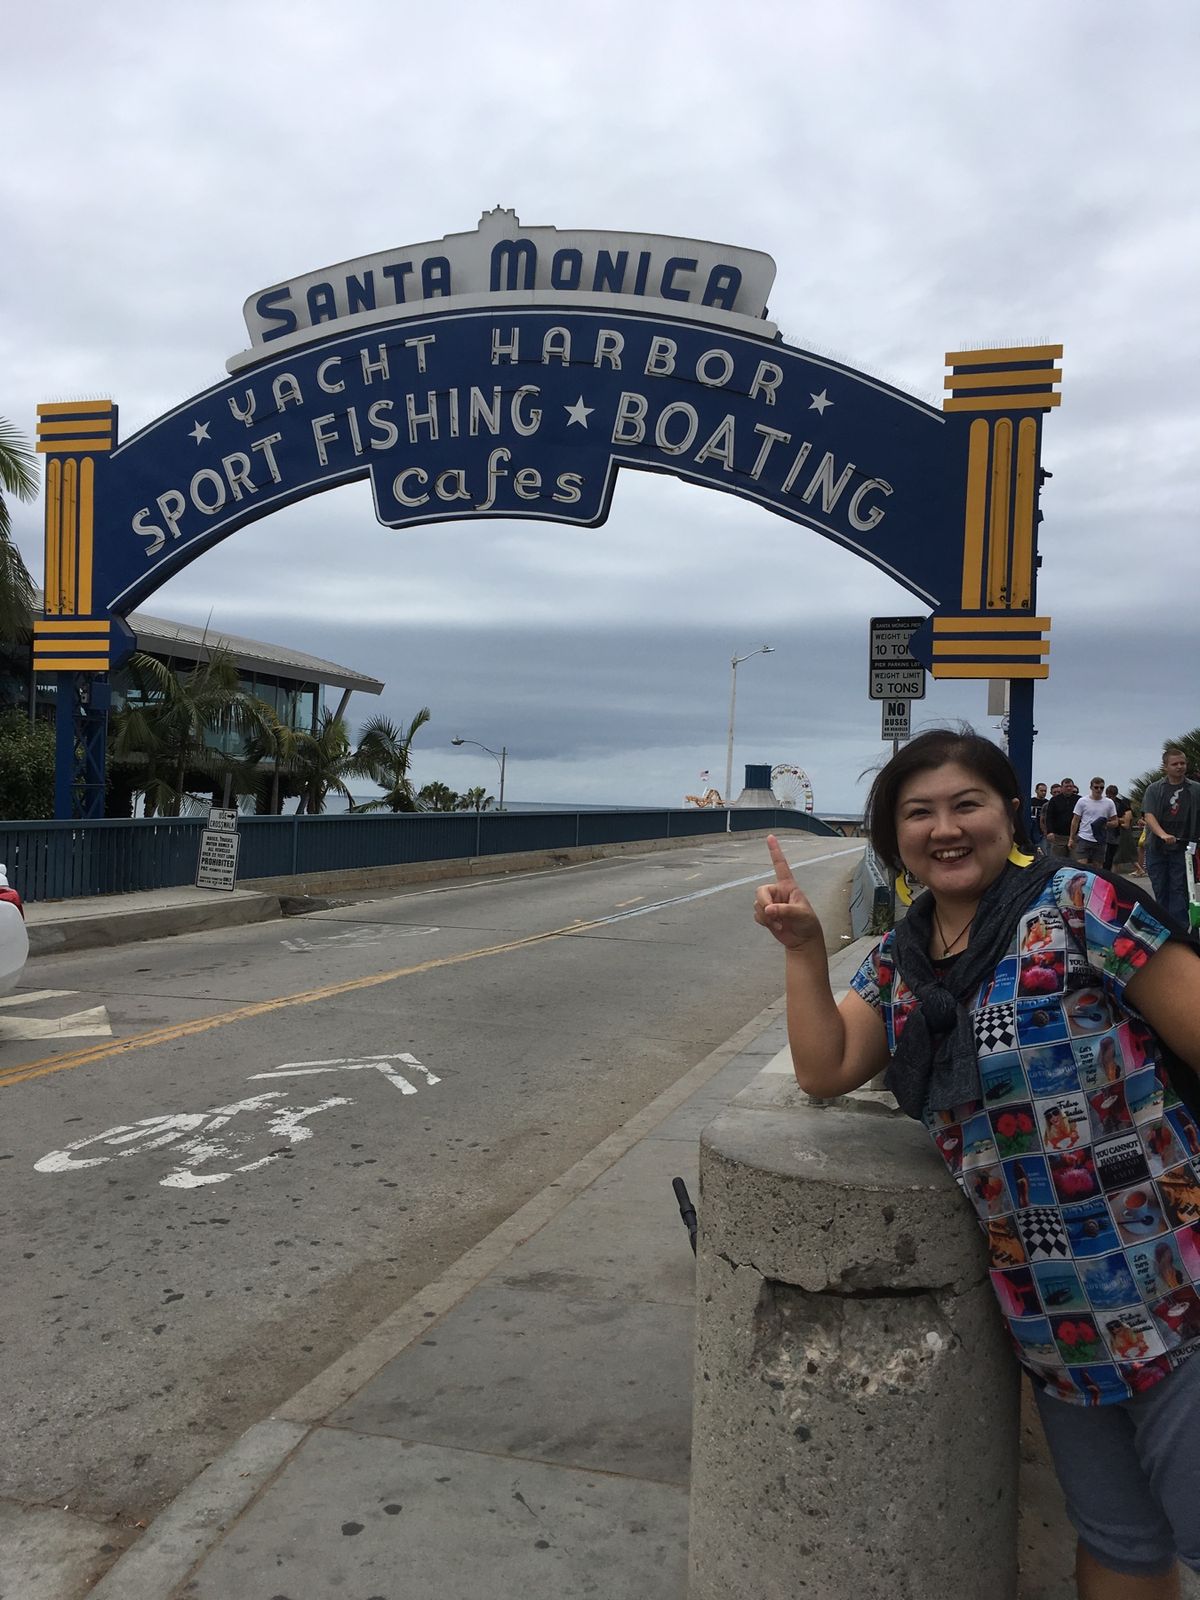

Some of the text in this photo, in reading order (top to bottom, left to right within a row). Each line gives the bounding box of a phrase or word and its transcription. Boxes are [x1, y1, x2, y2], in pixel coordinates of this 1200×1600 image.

[256, 238, 742, 342] SANTA MONICA
[228, 327, 784, 426] YACHT HARBOR
[132, 385, 894, 557] SPORT FISHING BOATING
[393, 448, 585, 511] cafes
[875, 644, 908, 655] 10 TO
[876, 682, 919, 694] 3 TONS
[888, 702, 906, 716] NO
[885, 718, 908, 726] BUSES
[210, 820, 235, 828] CROSSWALK
[201, 858, 234, 868] PROHIBITED
[1096, 1140, 1138, 1158] YOU CANNOT
[1100, 1150, 1138, 1166] HAVE YOUR
